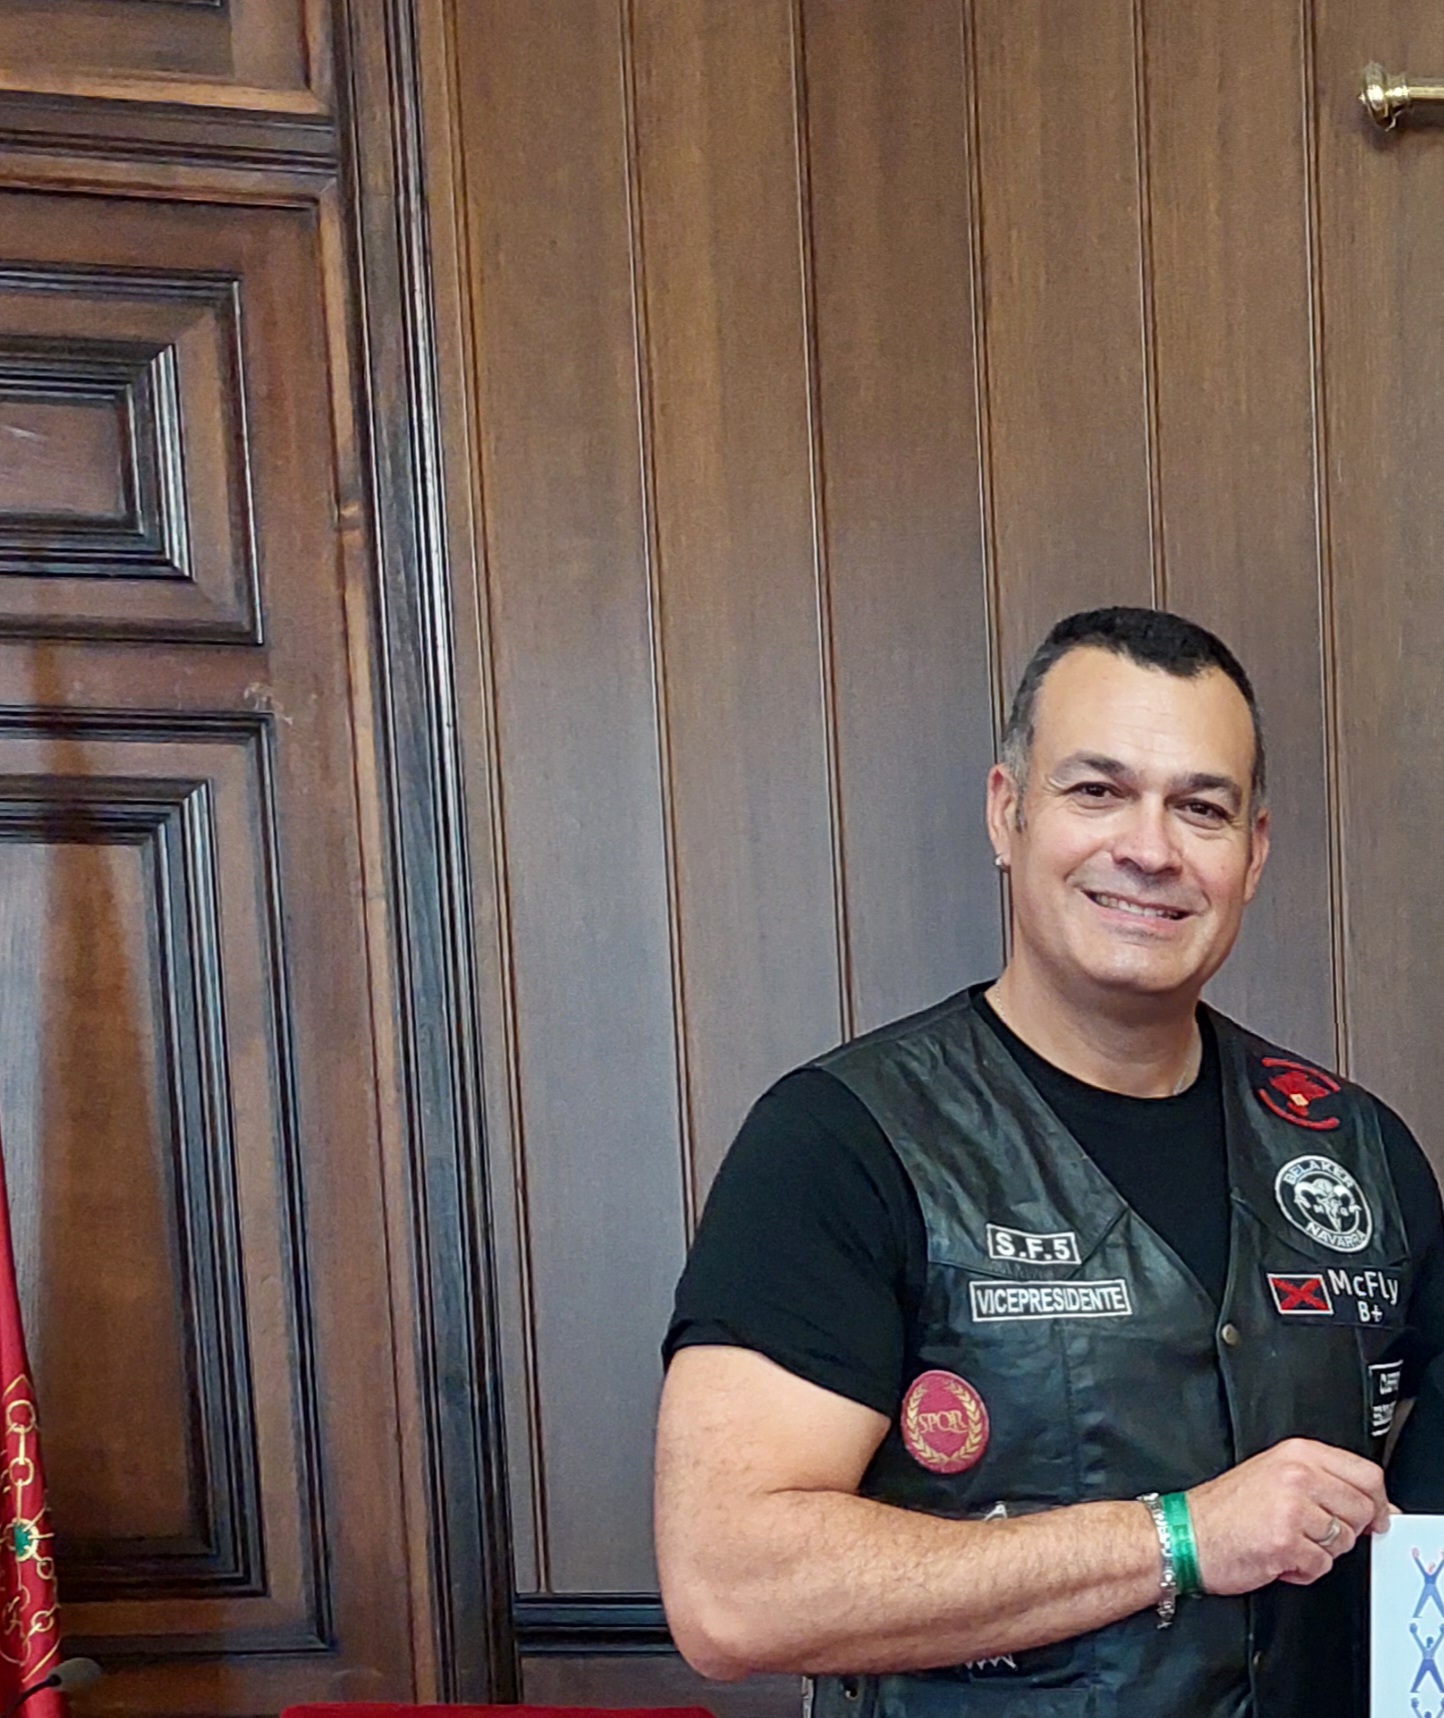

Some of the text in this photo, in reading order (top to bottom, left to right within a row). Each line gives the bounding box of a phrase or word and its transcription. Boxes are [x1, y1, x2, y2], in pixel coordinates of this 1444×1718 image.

[1283, 1159, 1354, 1188] BELAKER
[995, 1232, 1071, 1260] S.F.5
[1306, 1222, 1366, 1248] NAVARRA
[976, 1287, 1125, 1314] VICEPRESIDENTE
[1327, 1269, 1398, 1305] McFly
[1358, 1301, 1383, 1322] B+
[918, 1410, 969, 1434] SPQR
